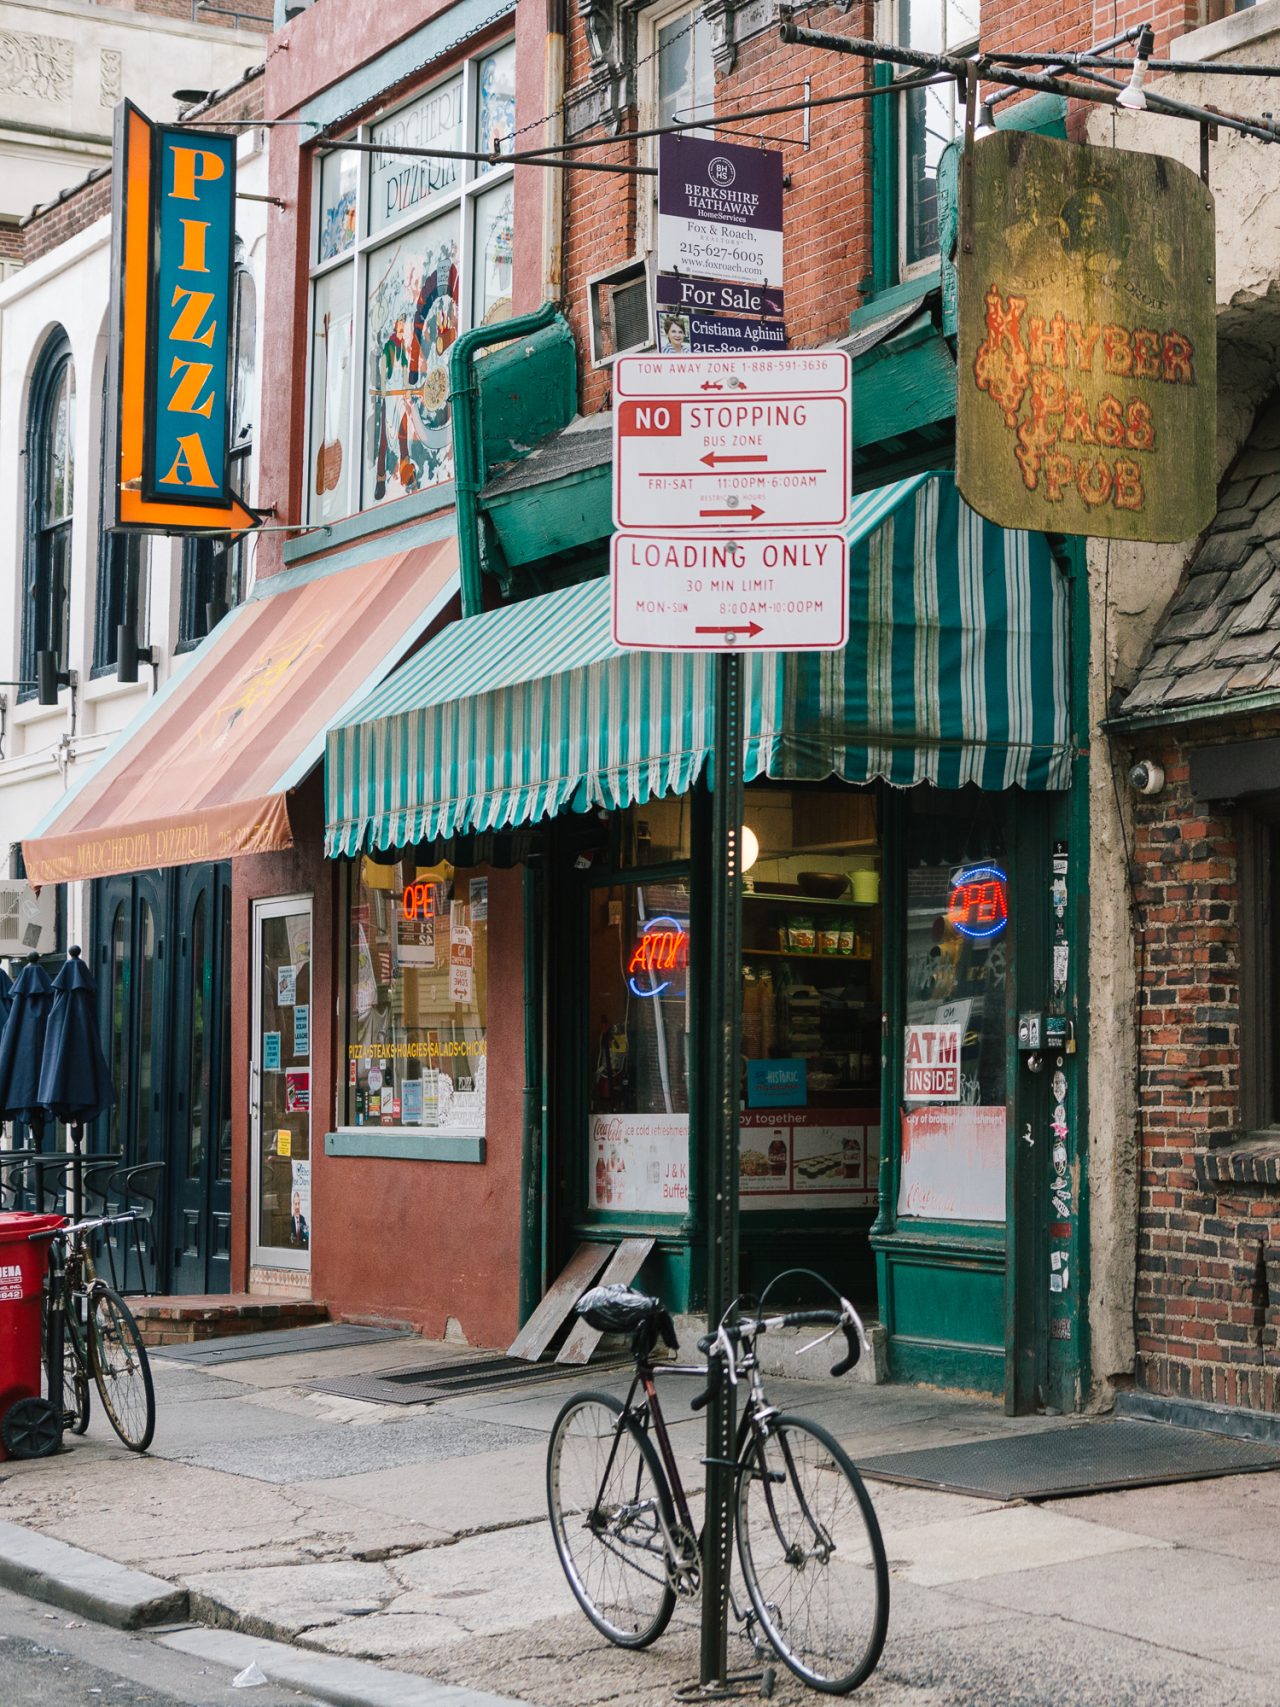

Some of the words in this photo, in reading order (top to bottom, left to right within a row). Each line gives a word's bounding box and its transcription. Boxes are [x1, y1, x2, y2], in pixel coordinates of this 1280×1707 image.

[371, 82, 464, 175] MARGHERIT
[386, 144, 456, 218] PIZZERIA
[685, 184, 759, 205] BERKSHIRE
[689, 196, 756, 216] HATHAWAY
[698, 209, 746, 223] HomeServices
[687, 221, 707, 234] Fox
[709, 224, 718, 236] &
[721, 226, 757, 242] Roach,
[680, 242, 764, 266] 215-627-6005
[681, 257, 762, 275] www.foxroach.com
[680, 283, 716, 305] For
[720, 287, 761, 310] Sale
[161, 145, 224, 489] PIZZA
[691, 320, 742, 338] Cristiana
[975, 284, 1194, 428] KHYBER
[638, 363, 663, 374] TOW
[669, 363, 701, 374] AWAY
[707, 362, 736, 374] ZONE
[741, 360, 828, 373] 1-888-591-3636
[635, 407, 671, 430] NO
[690, 405, 807, 429] STOPPING
[1015, 368, 1154, 491] PASS
[703, 435, 726, 447] BUS
[732, 434, 763, 446] ZONE
[648, 478, 694, 490] FRI-SAT
[717, 476, 817, 489] 11:00PM-6:00AM
[1043, 451, 1144, 511] PUB
[631, 543, 746, 569] LOADING
[762, 543, 828, 568] ONLY
[686, 579, 702, 592] 30
[710, 579, 734, 592] MIN
[741, 579, 774, 592] LIMIT
[636, 600, 688, 613] MON-SUN
[719, 600, 824, 614] 8:00AM-10:00PM
[77, 832, 151, 874] MARGHERITA
[156, 823, 210, 863] PIZZERIA
[950, 882, 1008, 922] OPEN
[370, 1043, 394, 1058] STEAKS
[429, 1041, 458, 1057] SALADS
[906, 1031, 958, 1064] ATM
[767, 1069, 799, 1084] HISTORIC
[909, 1070, 954, 1092] INSIDE
[756, 1112, 807, 1125] together
[636, 1124, 649, 1136] cold
[665, 1163, 669, 1178] J
[671, 1163, 678, 1178] &
[680, 1163, 686, 1178] K
[663, 1184, 688, 1199] Buffet
